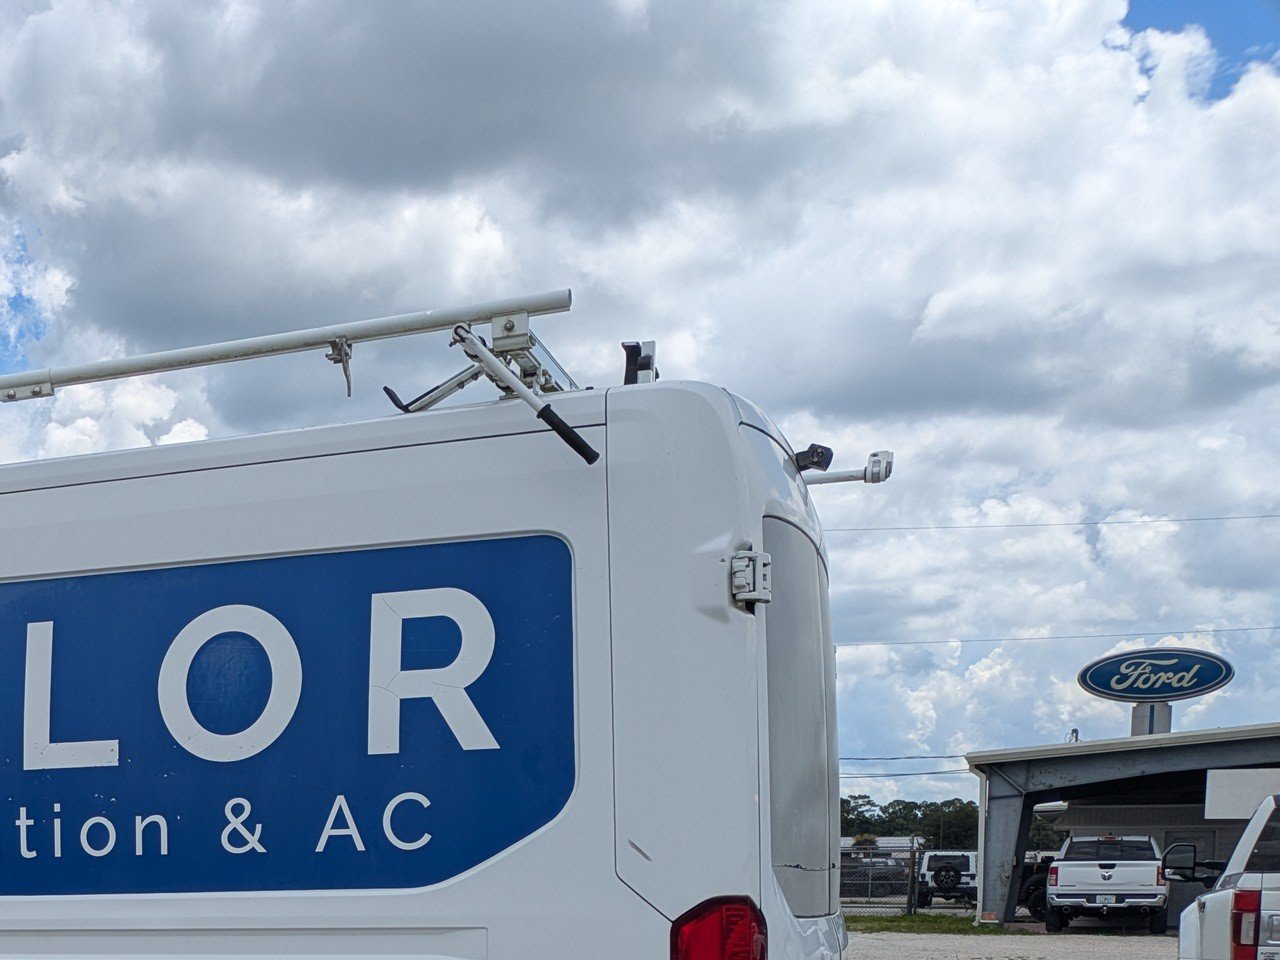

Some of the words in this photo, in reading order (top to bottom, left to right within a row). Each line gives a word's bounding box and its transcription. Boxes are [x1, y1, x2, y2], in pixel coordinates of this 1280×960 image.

[1110, 659, 1202, 690] Ford
[220, 796, 267, 854] &
[314, 791, 433, 852] AC
